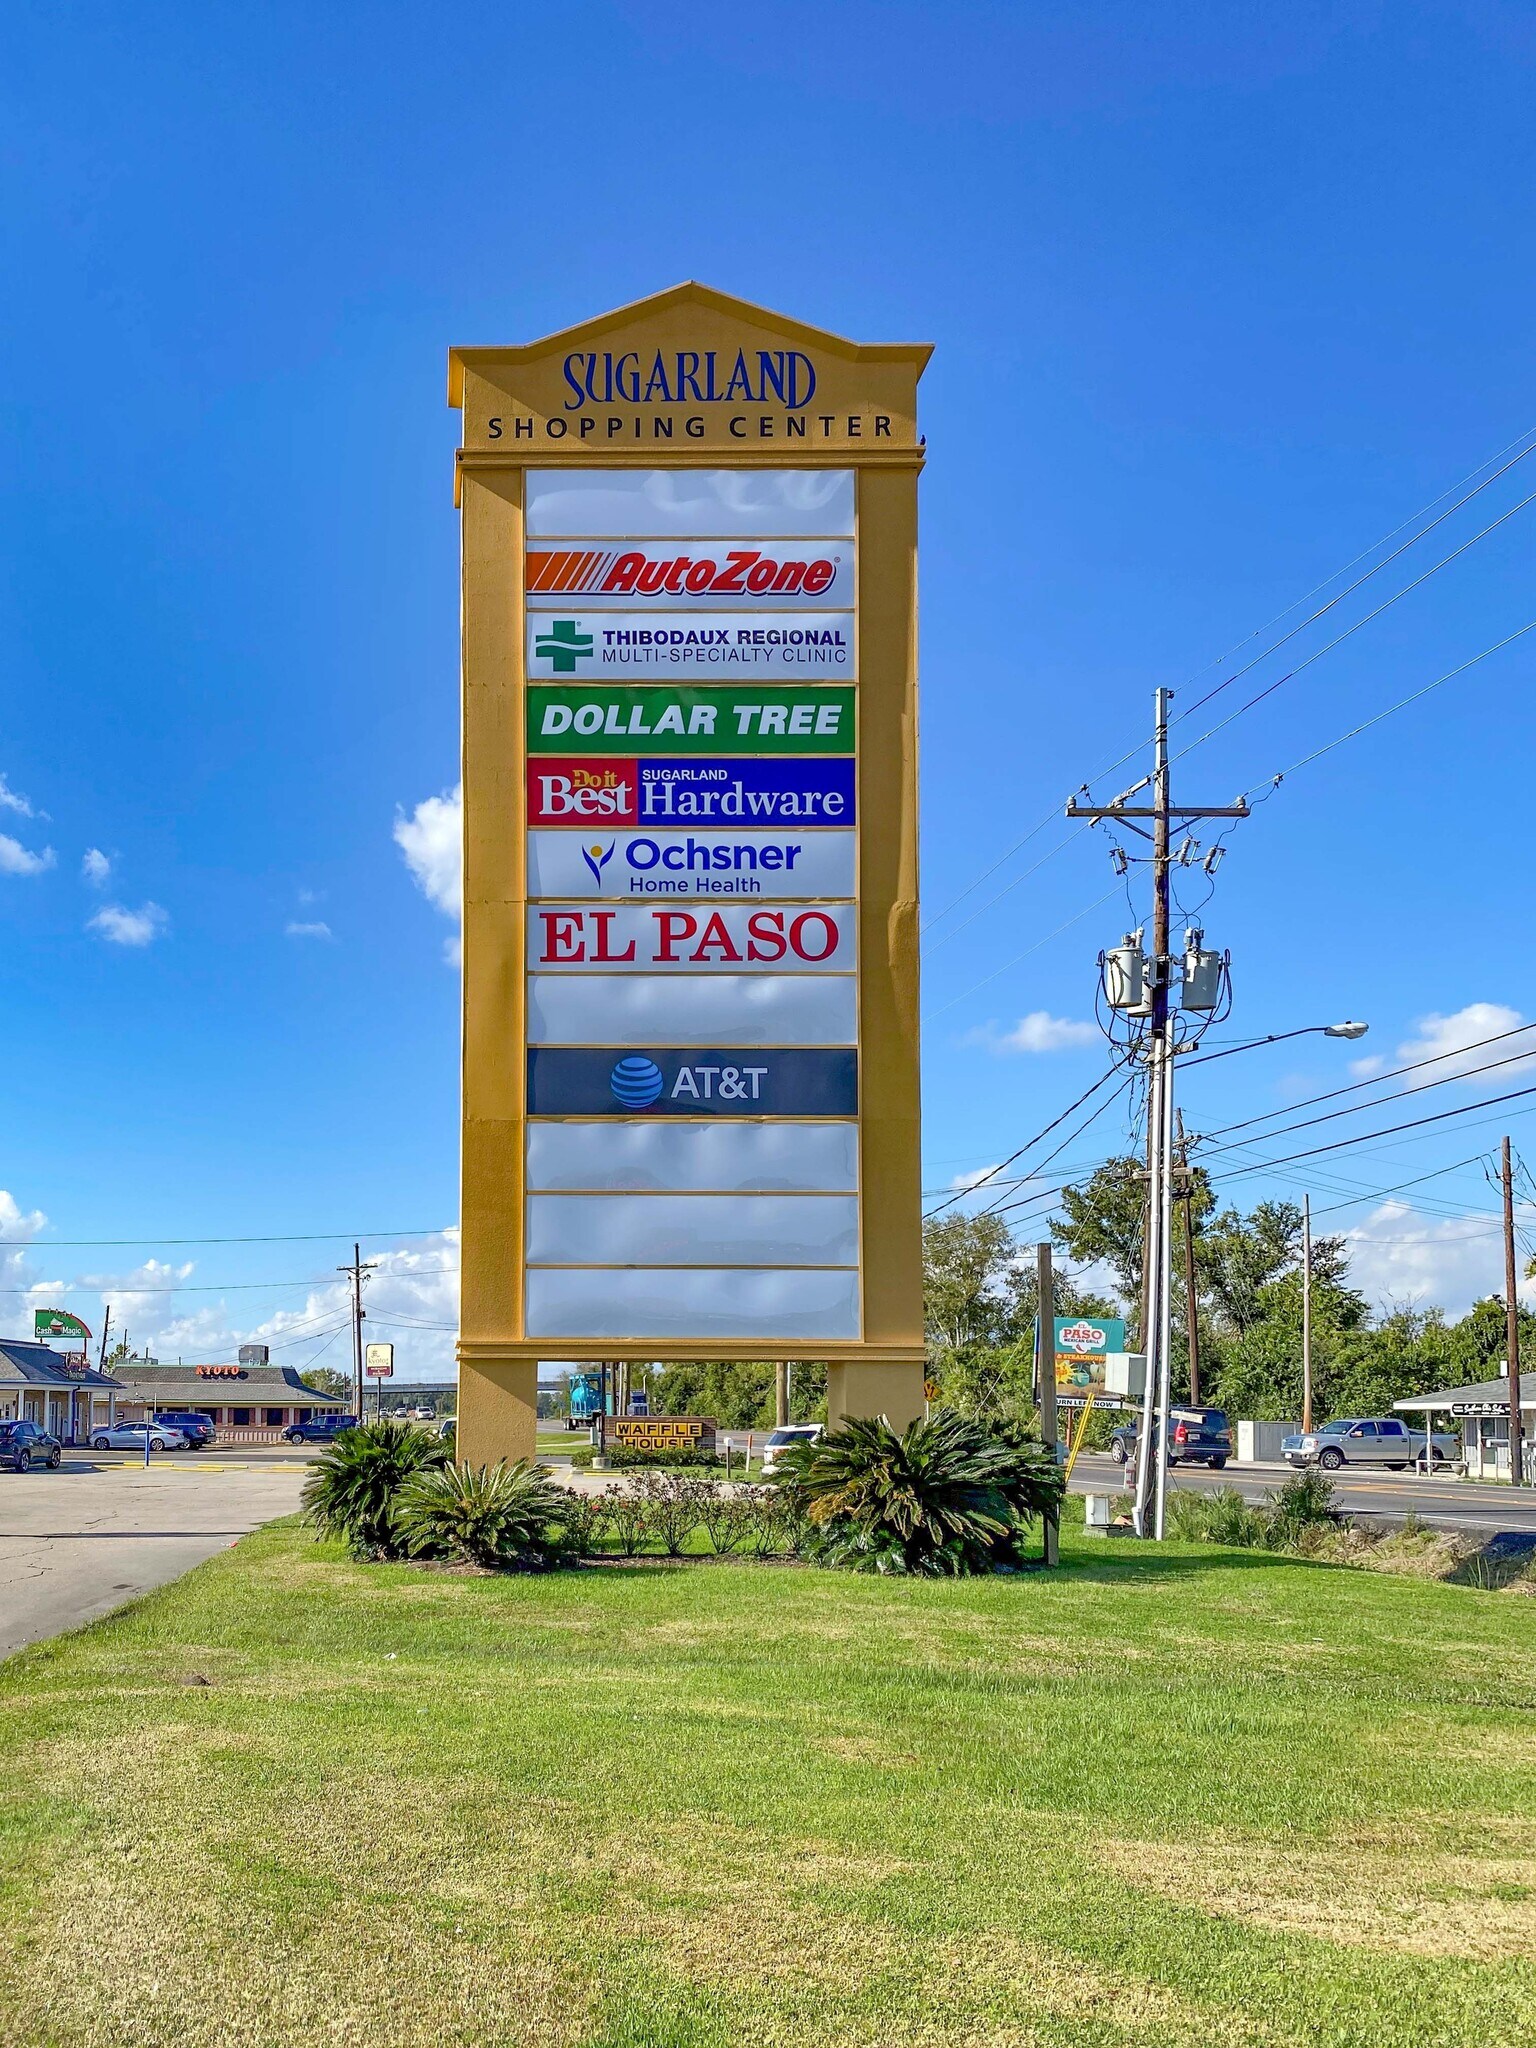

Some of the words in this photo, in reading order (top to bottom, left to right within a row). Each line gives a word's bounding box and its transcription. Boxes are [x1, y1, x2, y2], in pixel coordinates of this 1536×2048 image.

[563, 346, 817, 410] SUGARLAND
[488, 416, 706, 439] SHOPPING
[729, 415, 892, 437] CENTER
[601, 551, 837, 597] AutoZone
[602, 629, 730, 646] THIBODAUX
[737, 629, 847, 646] REGIONAL
[602, 648, 774, 663] MULTI-SPECIALTY
[782, 648, 847, 664] CLINIC
[540, 704, 718, 736] DOLLAR
[732, 704, 843, 735] TREE
[572, 769, 601, 788] Do
[604, 770, 618, 787] it
[642, 769, 728, 781] SUGARLAND
[537, 775, 633, 816] Best
[642, 781, 845, 816] Hardware
[625, 838, 802, 872] Ochsner
[630, 877, 689, 893] Home
[696, 876, 761, 893] Health
[539, 911, 637, 963] EL
[651, 911, 840, 962] PASO
[670, 1065, 769, 1100] AT&T
[36, 1326, 52, 1335] Cash
[62, 1326, 82, 1336] Magic
[1063, 1329, 1103, 1340] PASO
[195, 1364, 240, 1376] KYOTO
[618, 1424, 700, 1435] WAFFLE
[625, 1438, 693, 1449] HOUSE
